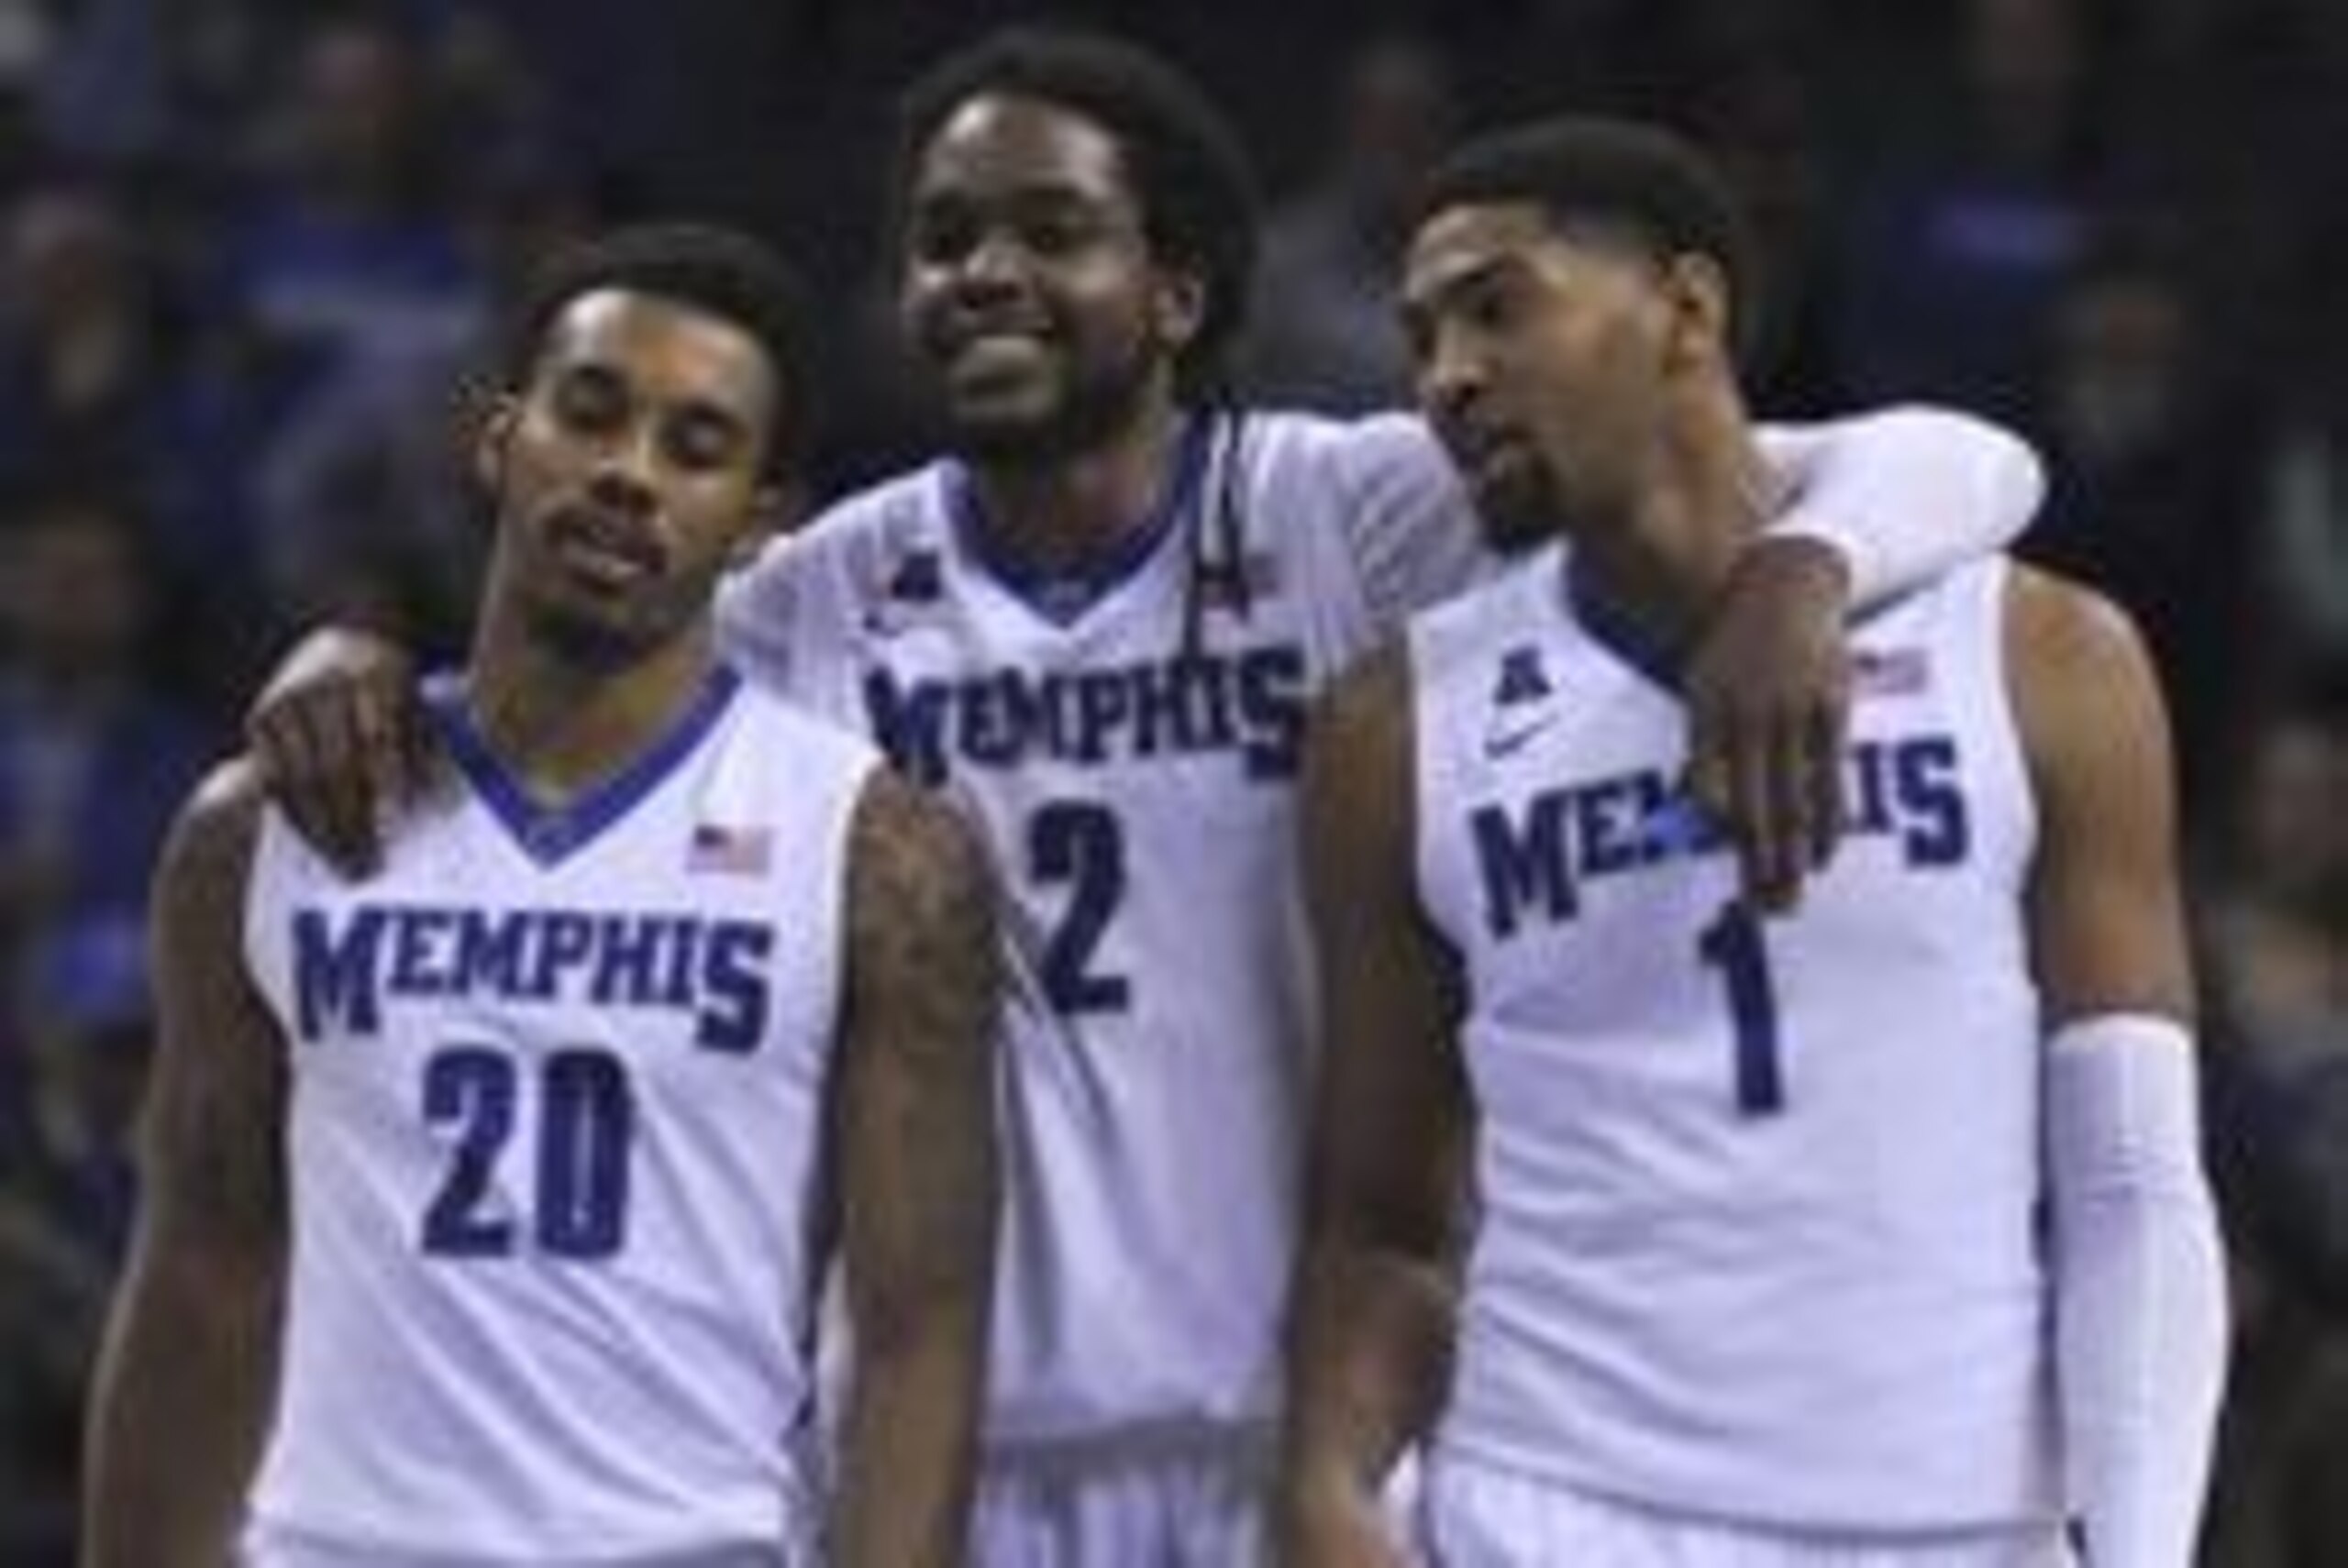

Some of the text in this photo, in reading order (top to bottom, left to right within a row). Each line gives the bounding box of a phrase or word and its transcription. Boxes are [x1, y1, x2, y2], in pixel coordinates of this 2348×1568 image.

[864, 646, 1307, 788] MEMPHIS
[1027, 799, 1129, 1013] 2
[1470, 734, 1969, 942] MEIS
[291, 908, 776, 1052] MEMPHIS
[1699, 899, 1783, 1118] 1
[421, 1045, 637, 1260] 20
